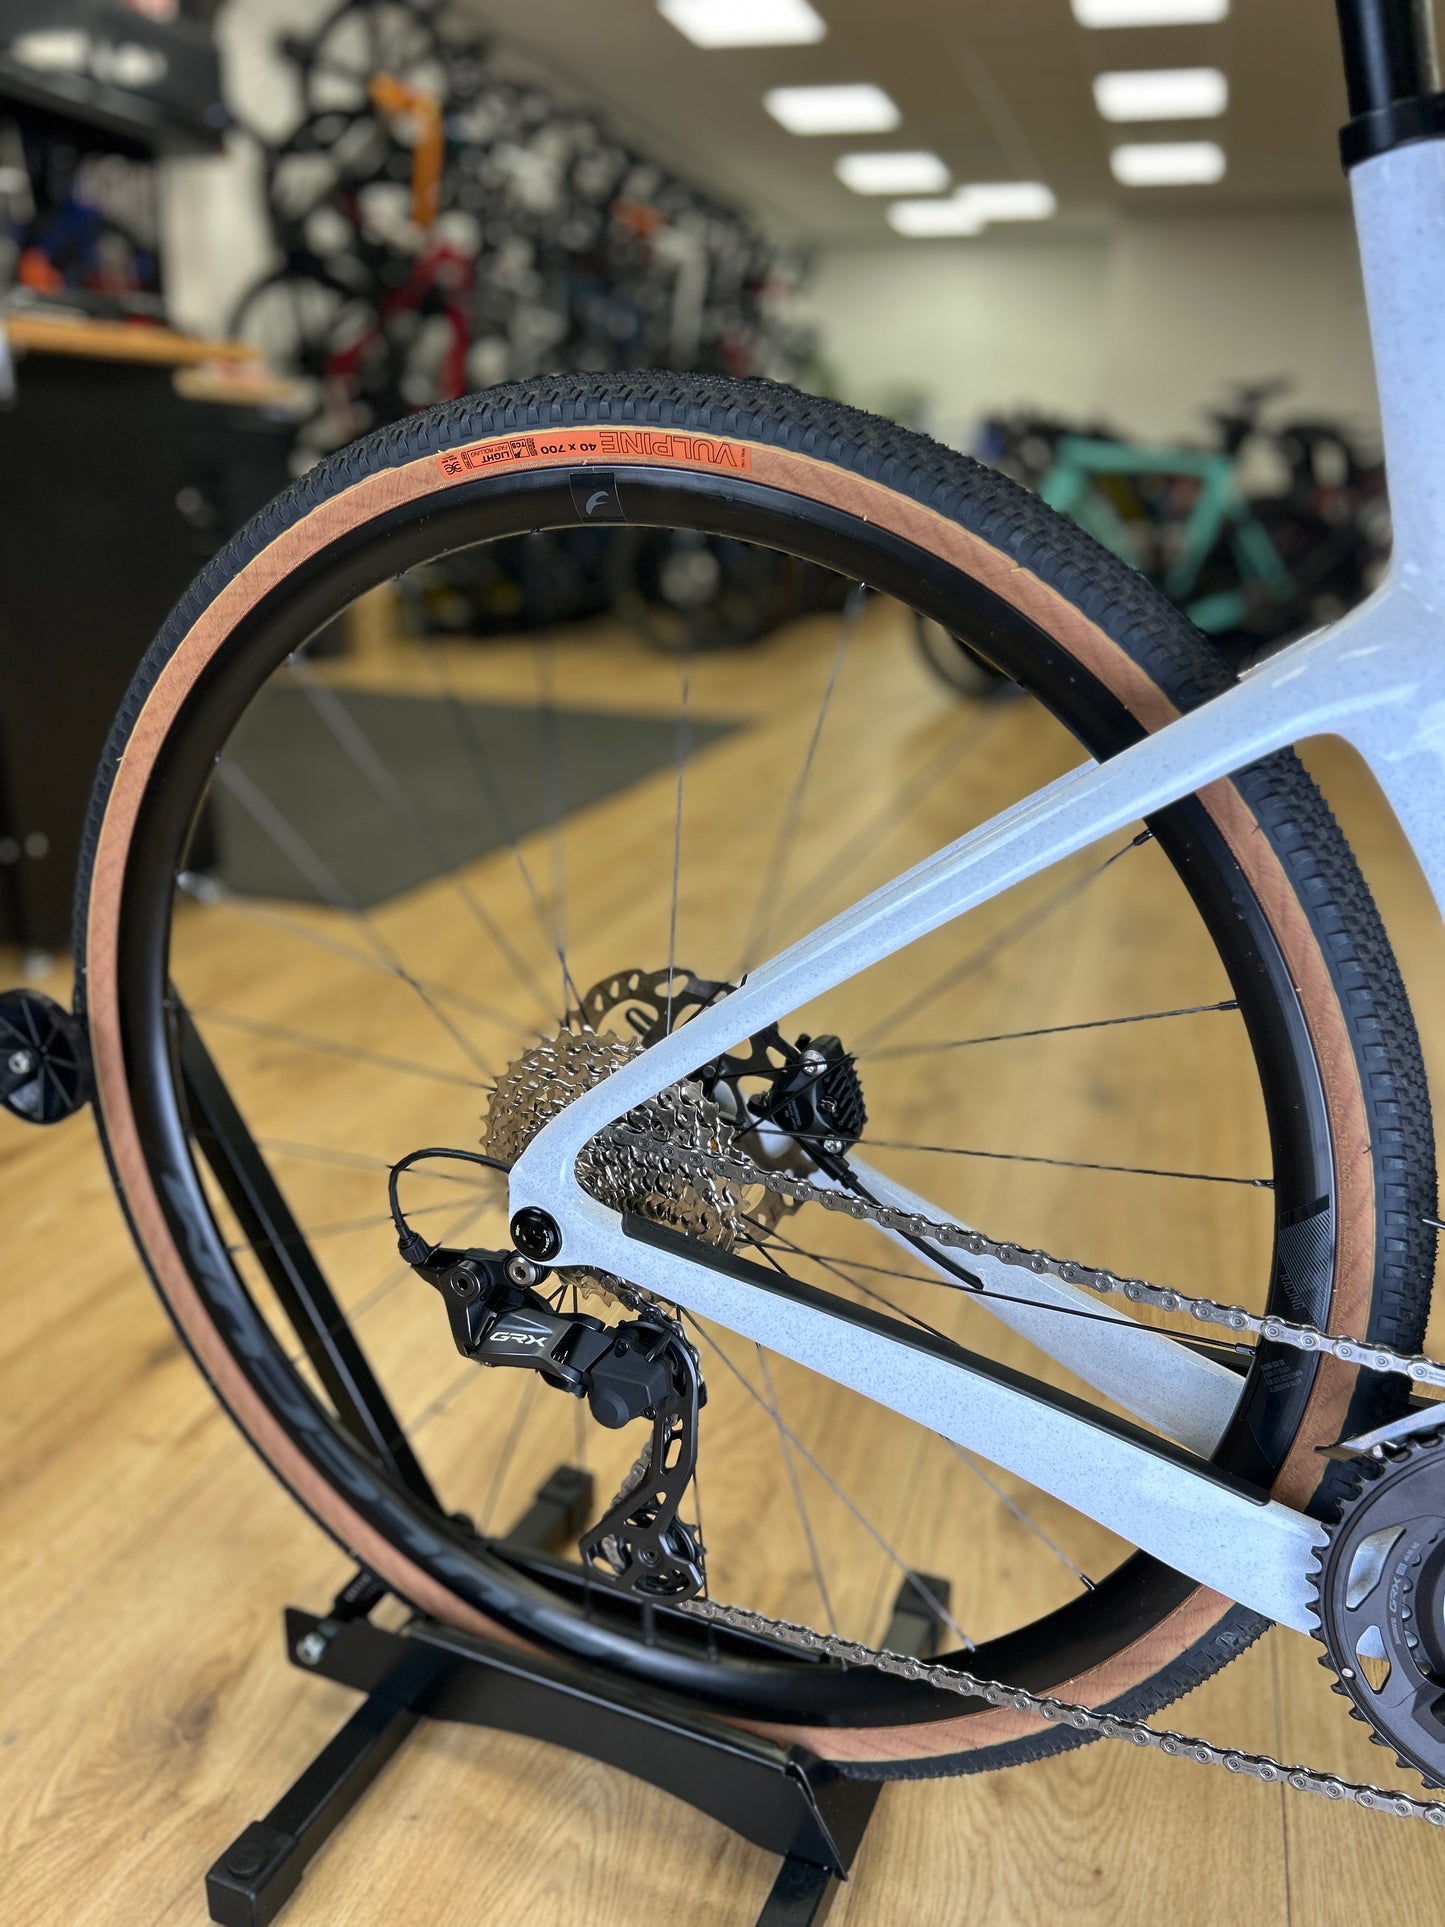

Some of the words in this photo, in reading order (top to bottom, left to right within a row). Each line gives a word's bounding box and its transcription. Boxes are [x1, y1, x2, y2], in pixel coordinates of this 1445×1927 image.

[493, 444, 508, 455] FAST
[511, 440, 526, 449] TCS
[540, 444, 566, 455] 700
[580, 443, 597, 452] 40
[599, 431, 738, 468] VULPINE
[471, 446, 493, 458] ROLLING
[482, 451, 511, 464] LIGHT
[1312, 1016, 1334, 1066] VULPINE
[1341, 1158, 1352, 1190] 700C
[1341, 1219, 1354, 1291] WILDERNESS
[1280, 1272, 1306, 1311] RACING
[489, 1331, 548, 1347] GRX
[1389, 1576, 1402, 1613] GRX
